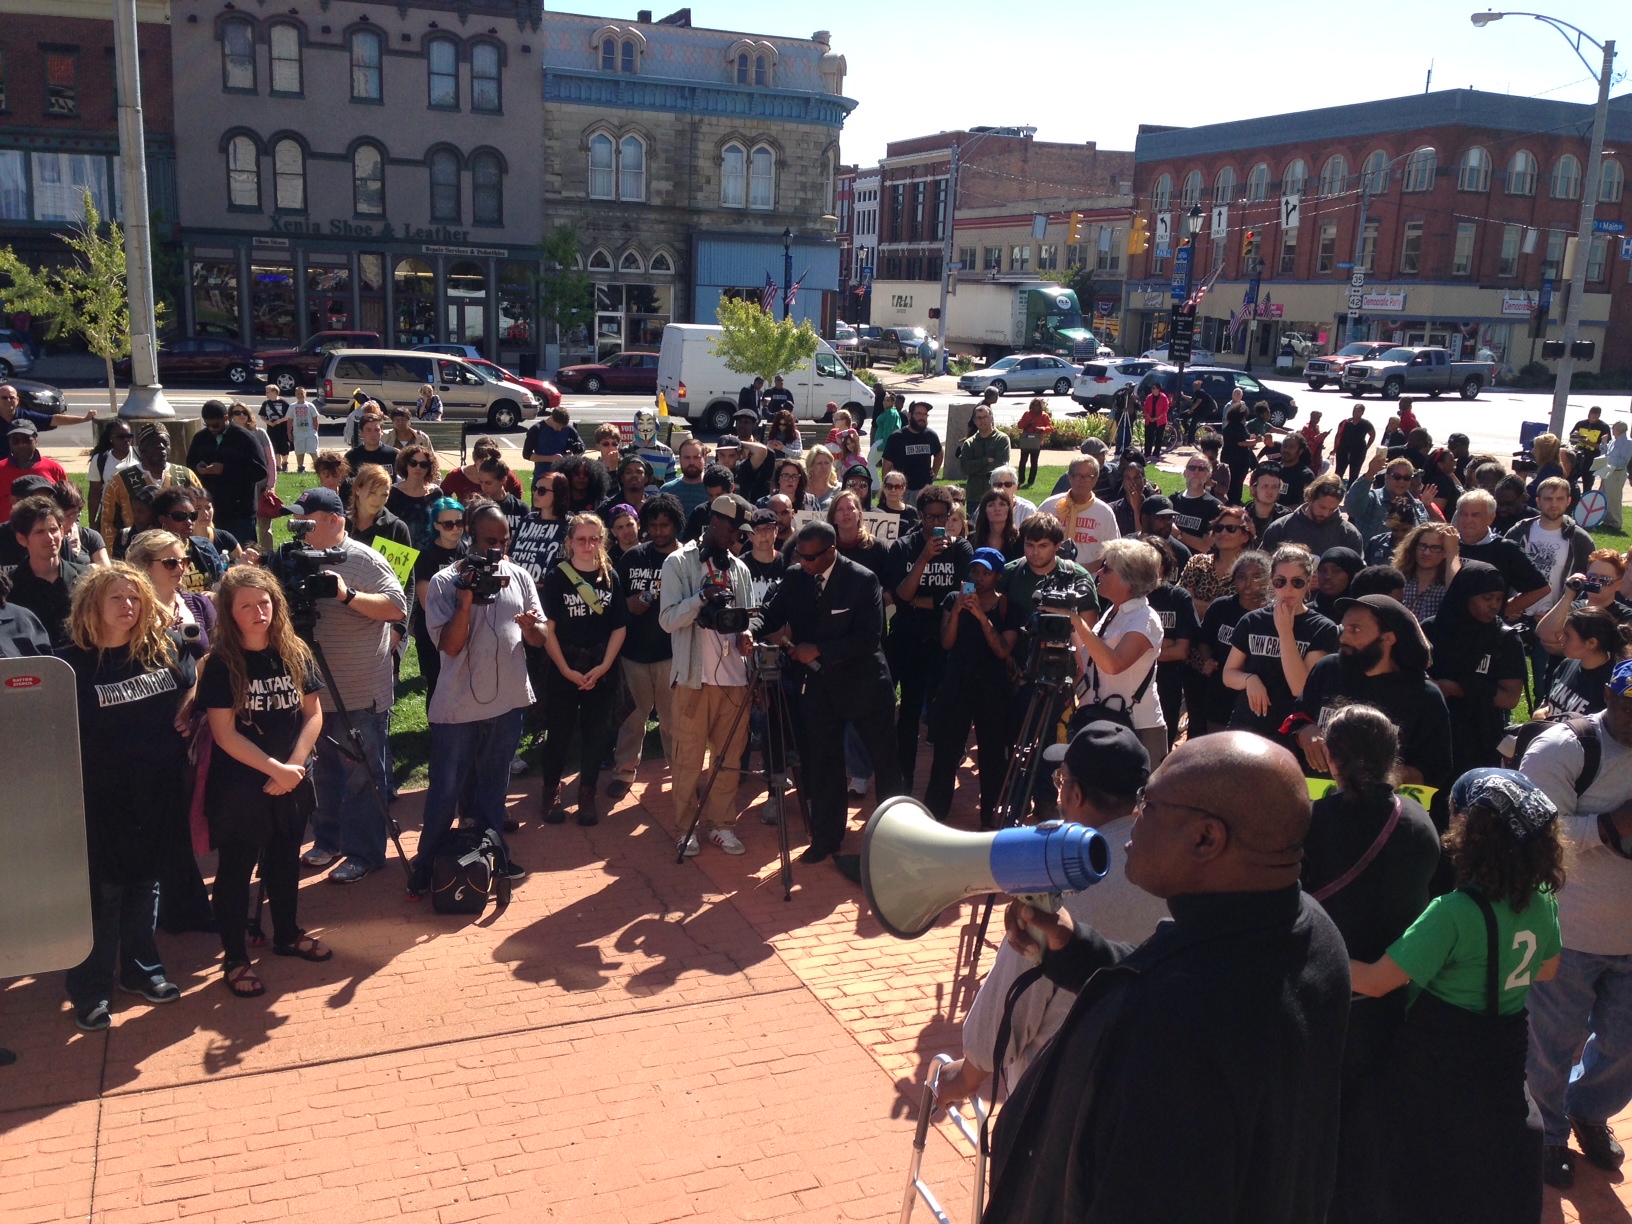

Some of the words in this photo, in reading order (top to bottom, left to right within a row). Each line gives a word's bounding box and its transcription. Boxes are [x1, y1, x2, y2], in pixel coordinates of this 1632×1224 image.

[269, 215, 320, 232] Xenia
[330, 219, 373, 236] Shoe
[382, 222, 396, 238] &
[403, 223, 470, 241] Leather
[1603, 222, 1619, 230] Main
[1364, 297, 1388, 307] Democratic
[517, 521, 560, 541] WHEN
[514, 541, 547, 553] WILL
[512, 551, 537, 563] THIS
[631, 579, 647, 590] THE
[929, 574, 954, 586] POLIC
[568, 605, 586, 617] THE
[98, 684, 125, 705] JOHN
[121, 670, 176, 700] CRAWFORD
[1504, 930, 1537, 991] 2
